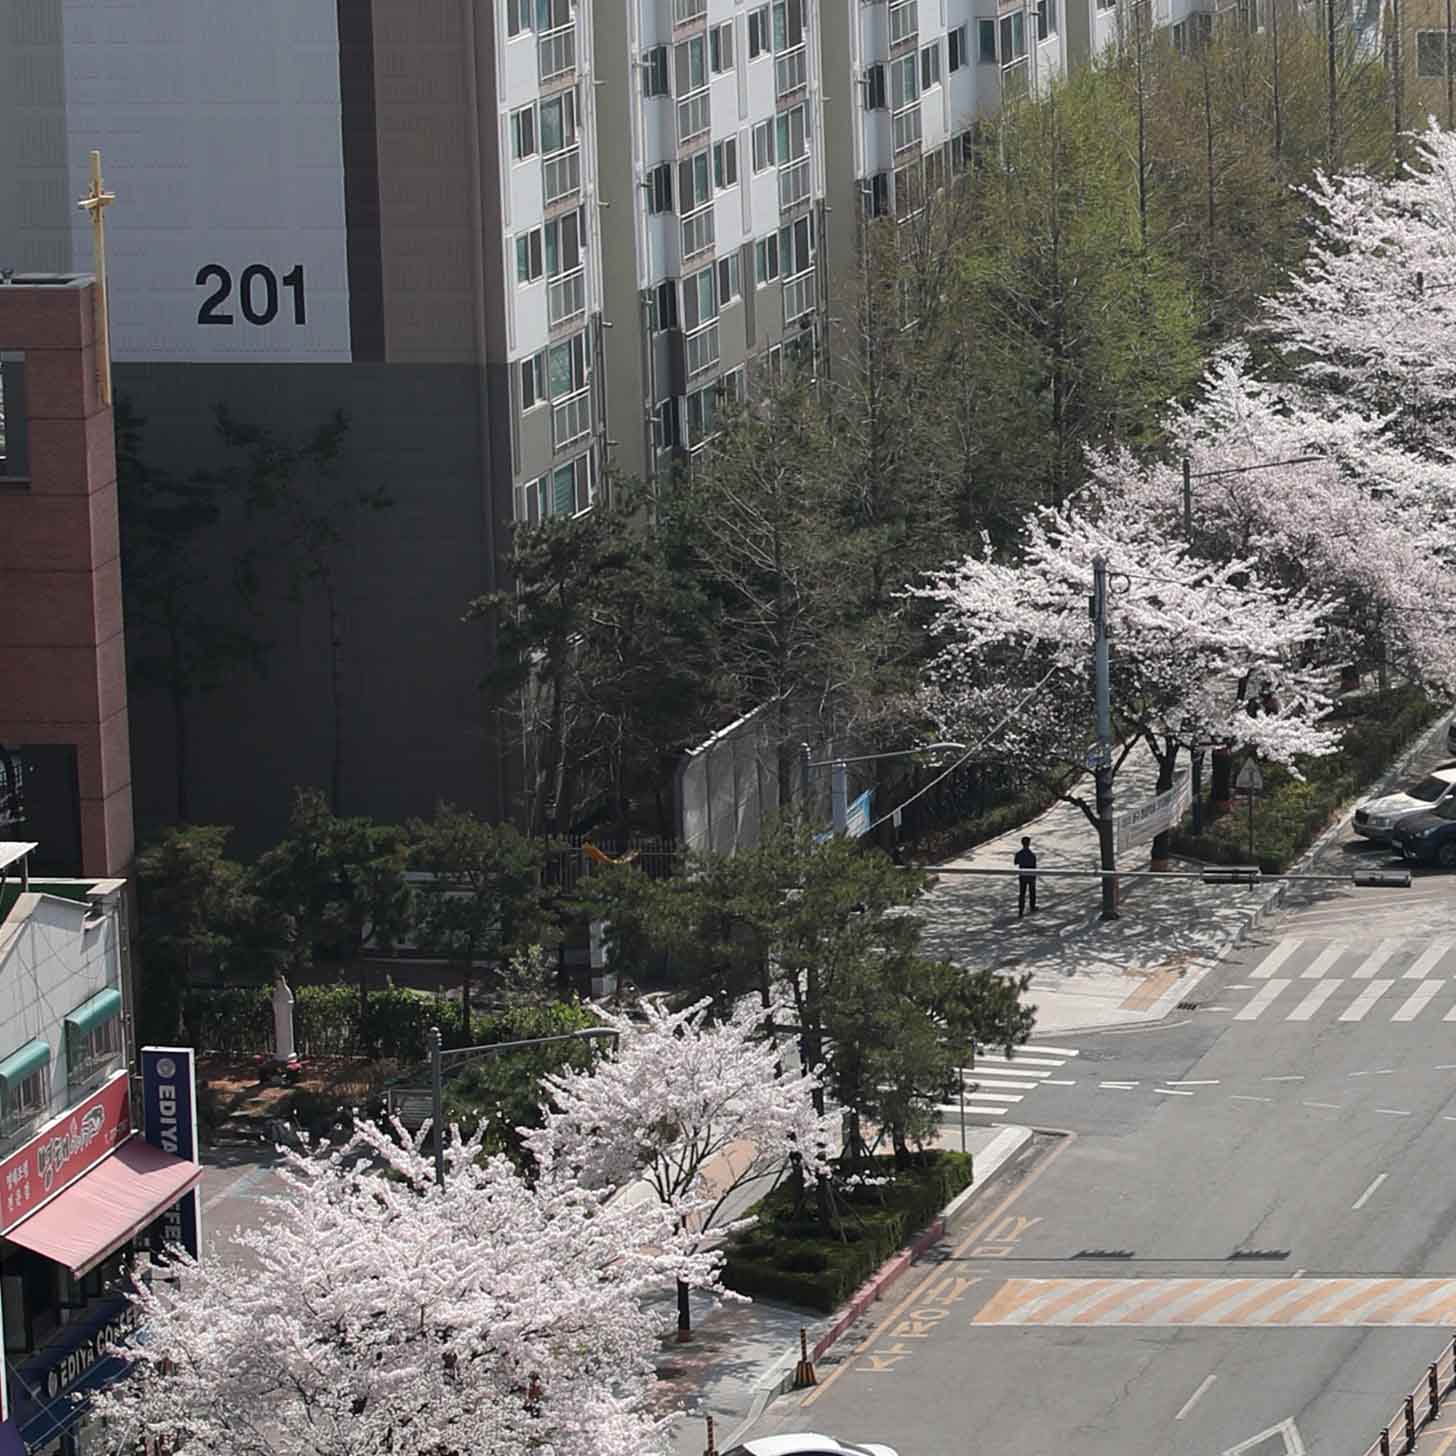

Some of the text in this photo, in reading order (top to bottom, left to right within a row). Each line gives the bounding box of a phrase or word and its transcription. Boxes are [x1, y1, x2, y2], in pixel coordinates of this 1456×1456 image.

[195, 263, 306, 326] 201
[158, 1084, 179, 1154] EDIYA
[60, 1340, 95, 1389] EDIYA
